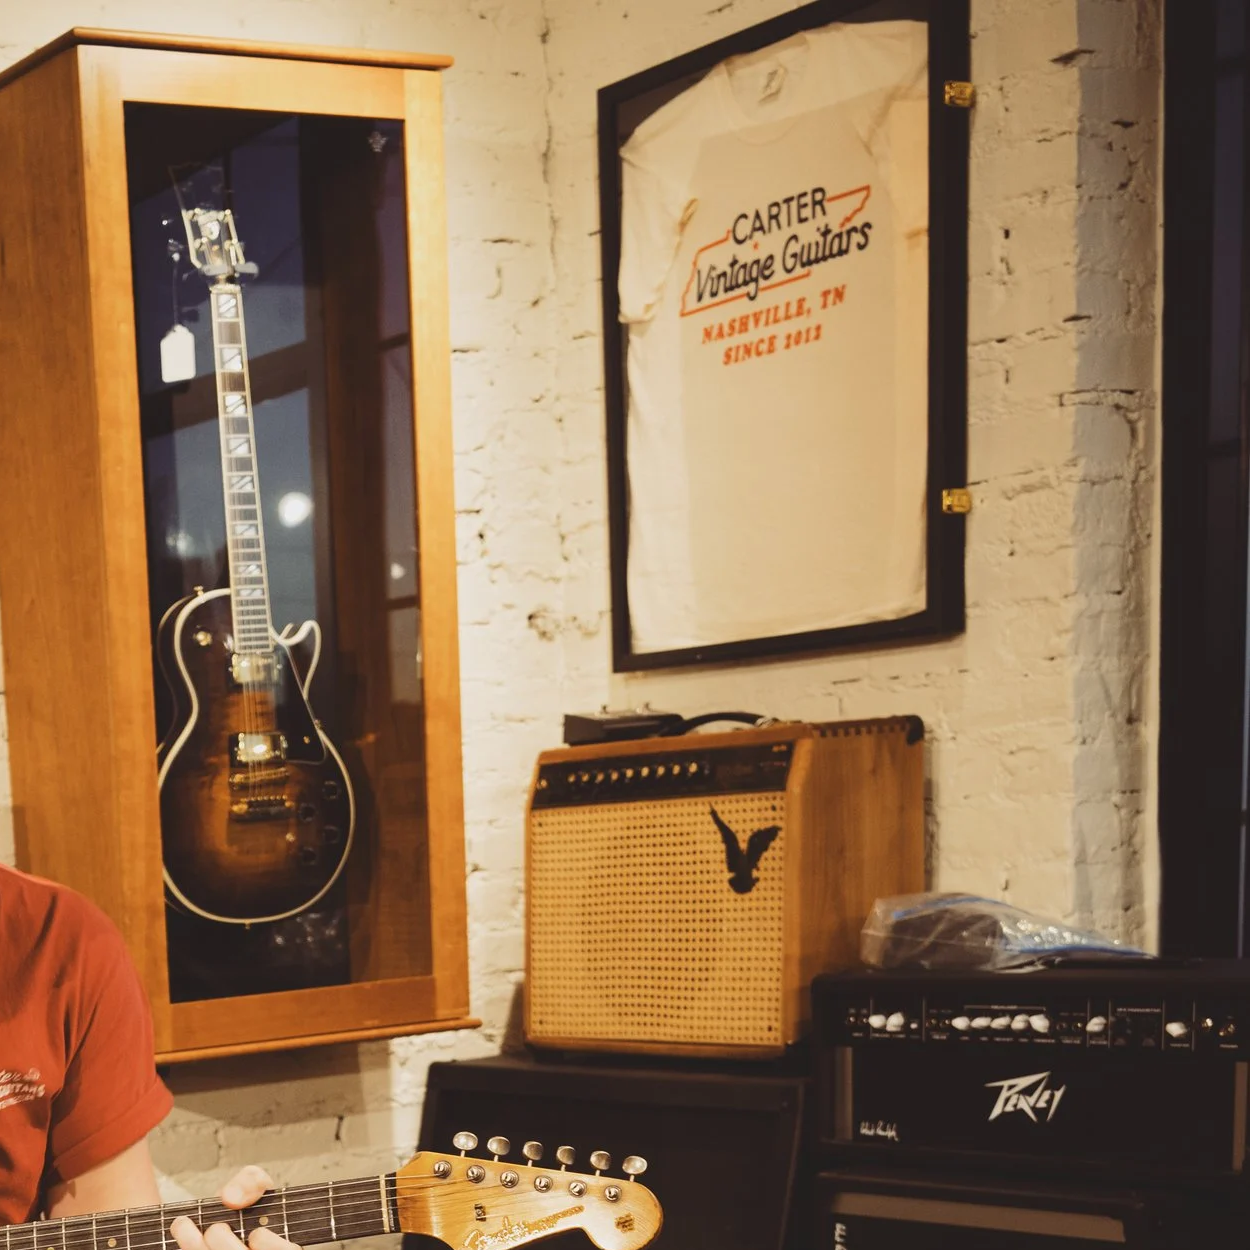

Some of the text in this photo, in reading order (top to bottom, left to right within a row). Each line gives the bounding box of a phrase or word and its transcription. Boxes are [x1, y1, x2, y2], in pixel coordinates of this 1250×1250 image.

[732, 187, 827, 245] CARTER
[696, 221, 873, 303] Vintage Guitars
[701, 283, 847, 344] NASHVILLE, TN
[722, 334, 777, 366] SINCE
